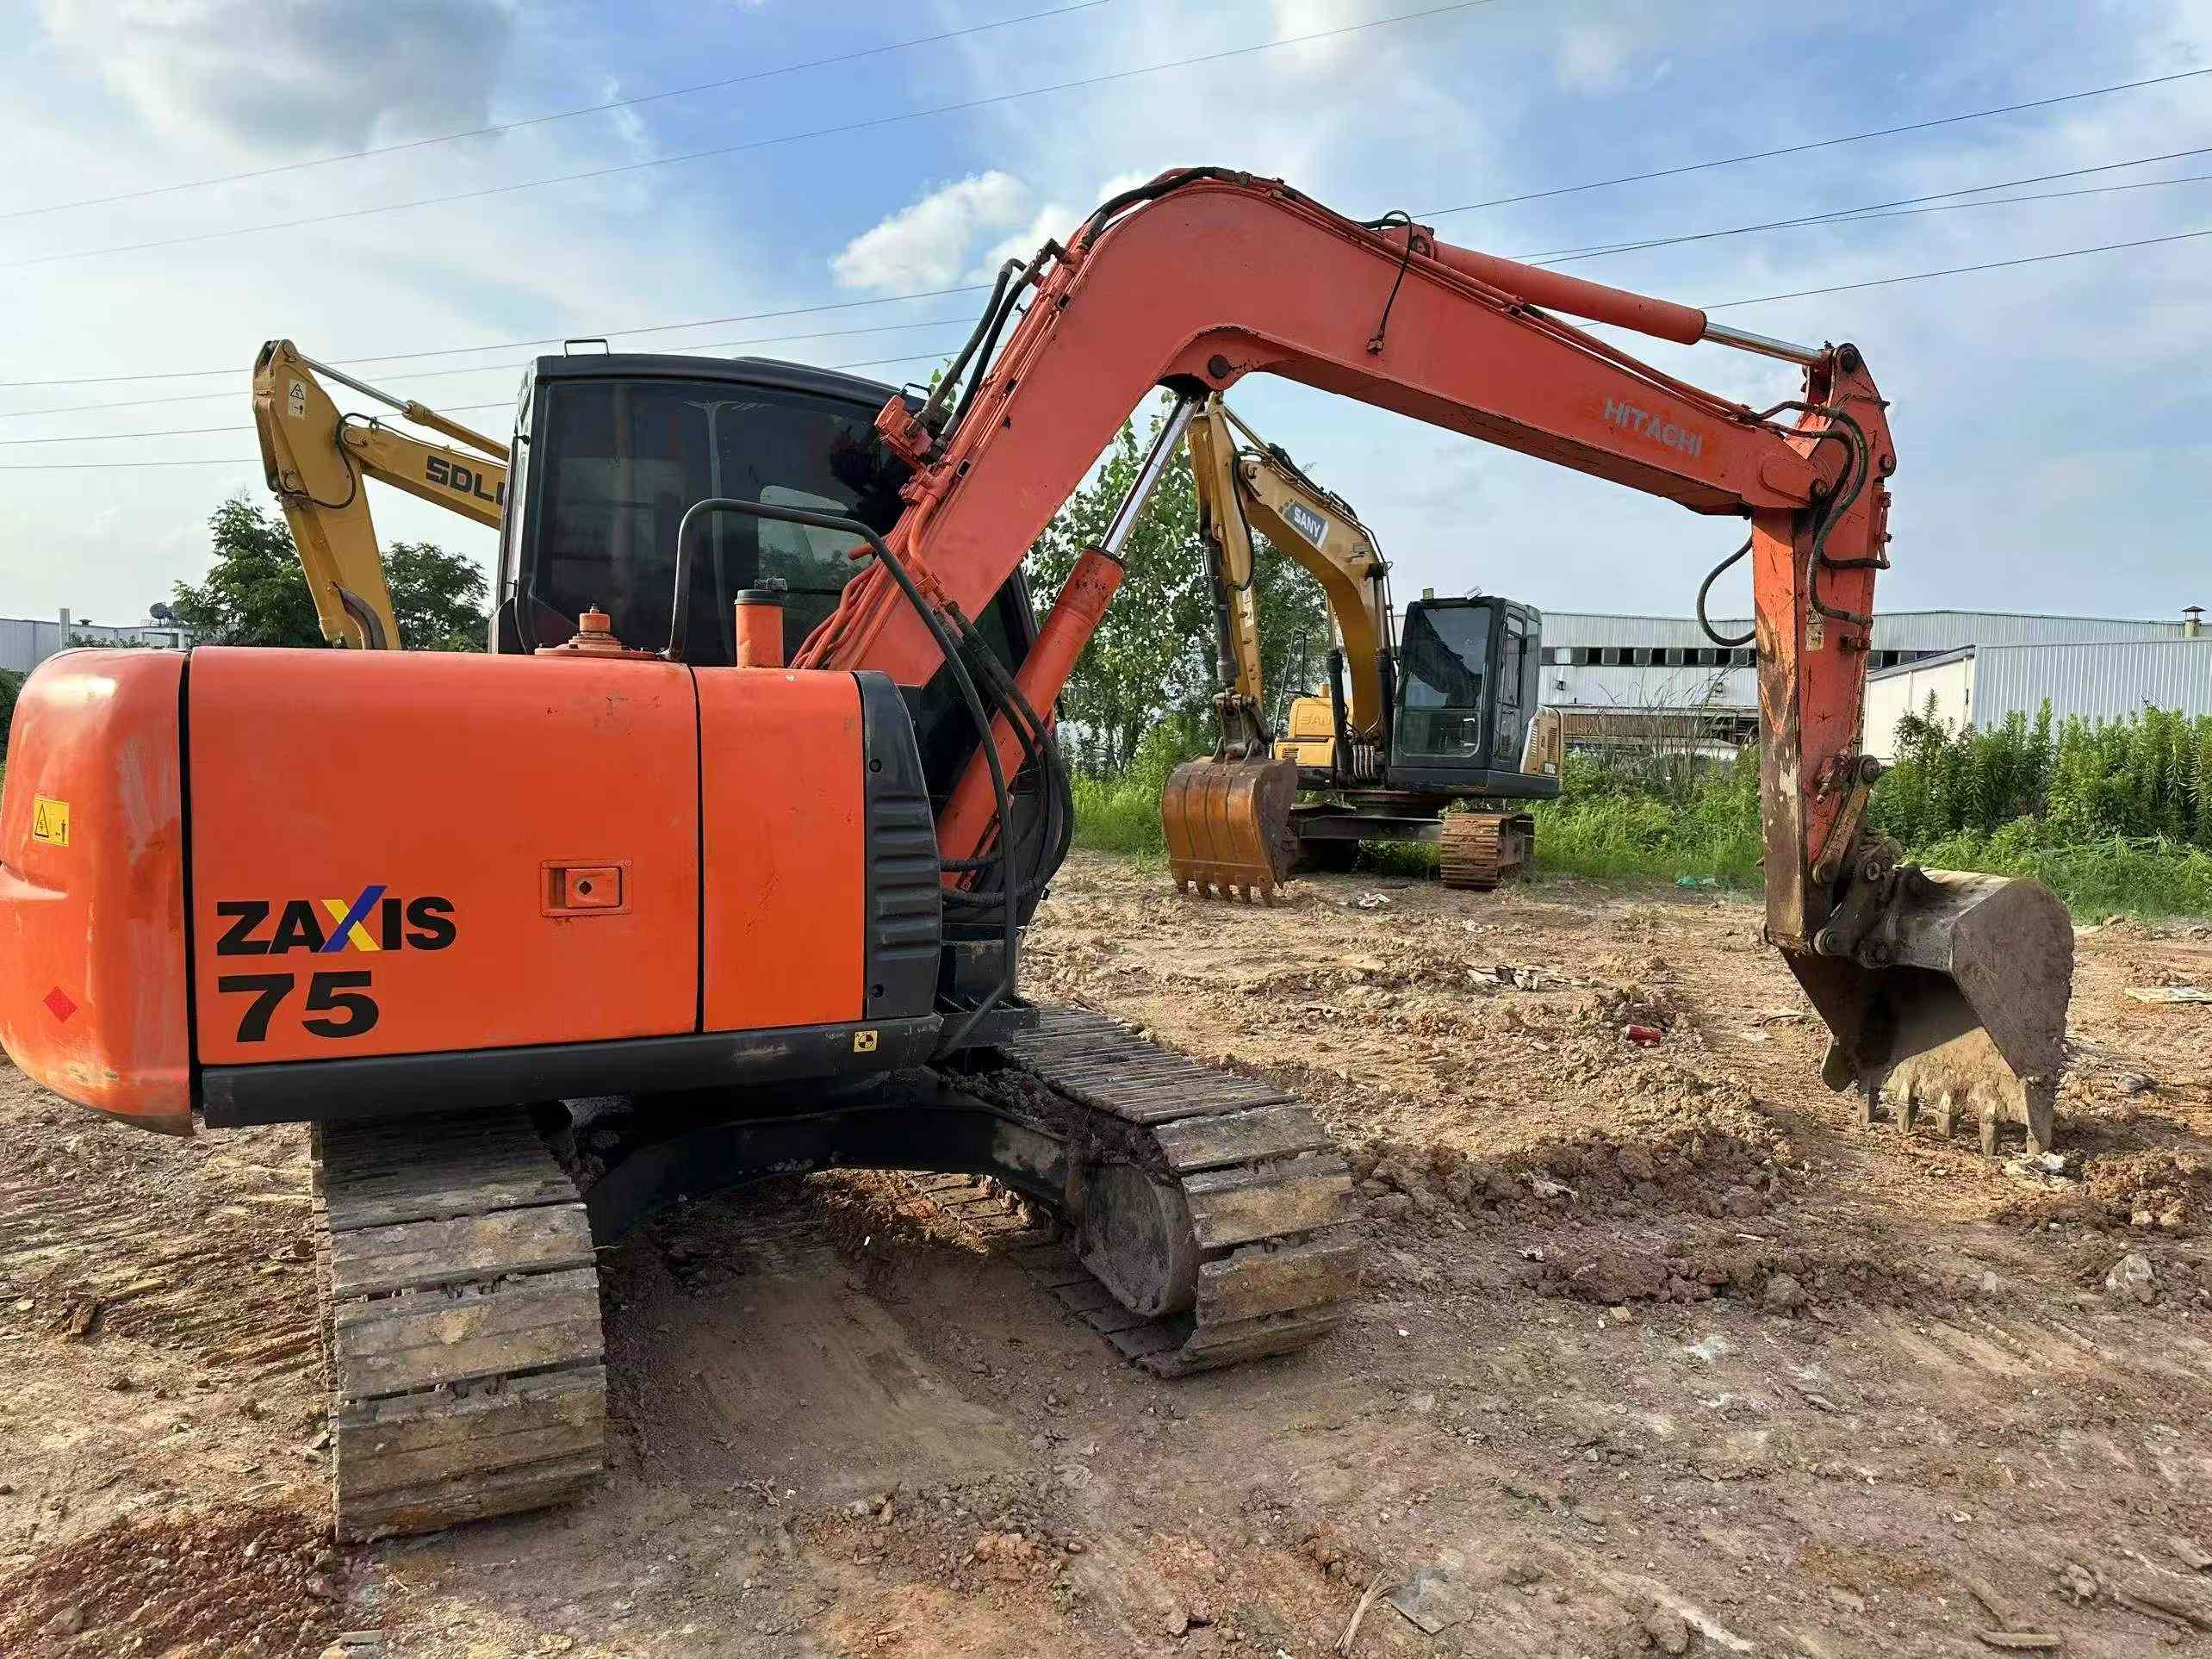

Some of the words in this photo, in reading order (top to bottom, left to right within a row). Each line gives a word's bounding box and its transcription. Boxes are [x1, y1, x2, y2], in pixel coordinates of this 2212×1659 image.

[1603, 395, 1703, 456] HITACHI
[1294, 505, 1320, 537] SANY
[216, 885, 457, 955] ZAXIS
[217, 970, 380, 1043] 75
